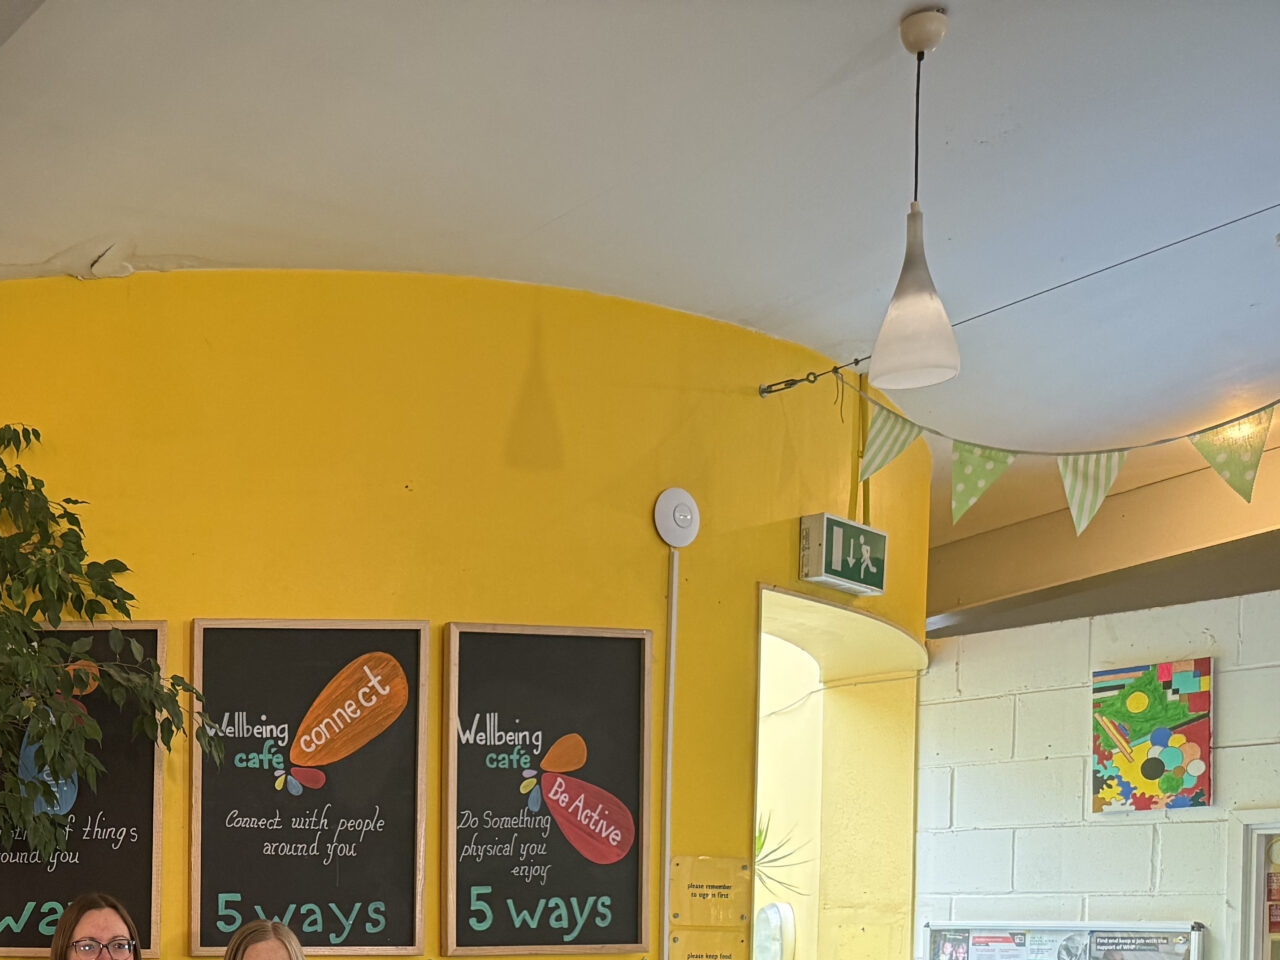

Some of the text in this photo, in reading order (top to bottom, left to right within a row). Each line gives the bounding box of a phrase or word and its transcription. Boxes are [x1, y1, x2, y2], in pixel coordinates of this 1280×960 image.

[205, 712, 288, 746] Wellbeing
[457, 712, 542, 755] Wellbeing
[225, 804, 385, 843] Connect with people
[457, 807, 551, 838] Do Something
[548, 777, 621, 846] Be Active
[82, 811, 138, 849] things
[459, 833, 547, 862] physical you
[48, 846, 79, 872] you
[263, 832, 358, 865] around you
[510, 861, 552, 885] enjoy
[216, 893, 386, 944] 5 ways
[468, 886, 613, 942] 5 ways
